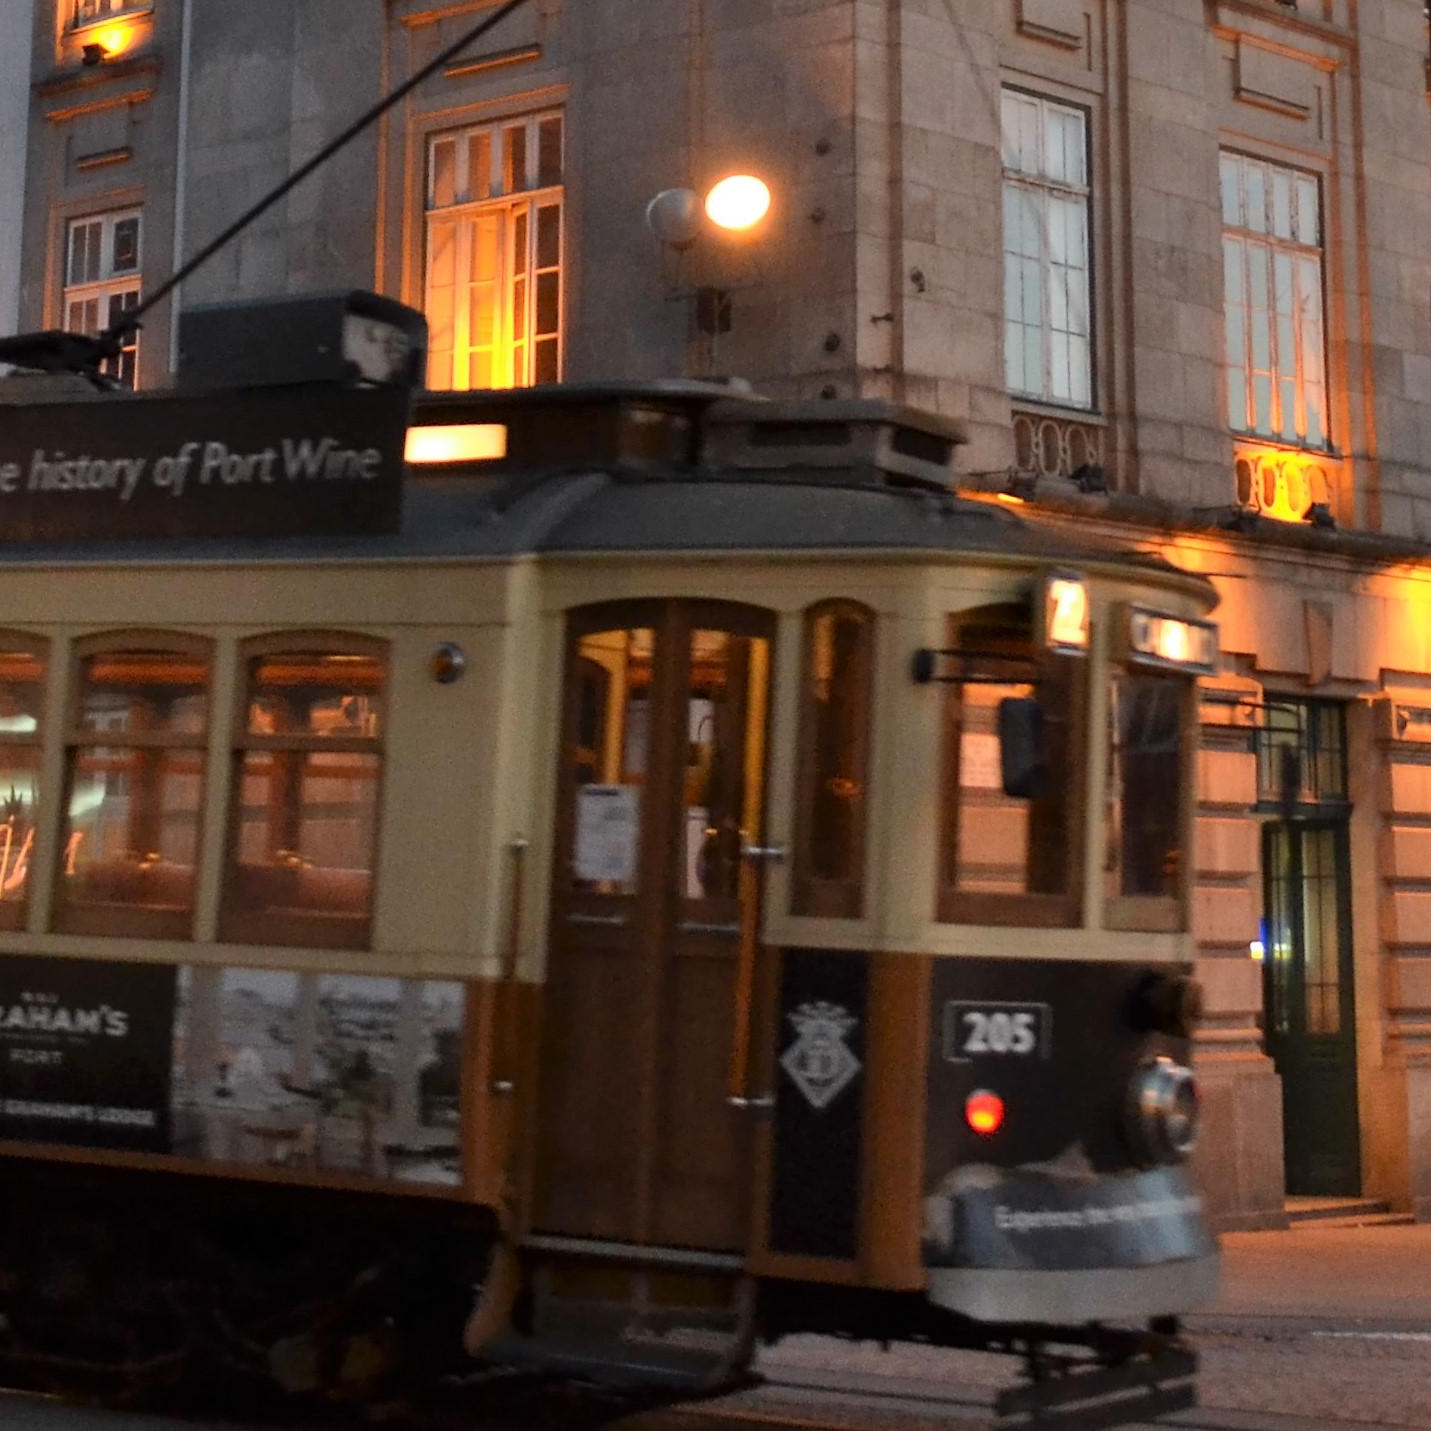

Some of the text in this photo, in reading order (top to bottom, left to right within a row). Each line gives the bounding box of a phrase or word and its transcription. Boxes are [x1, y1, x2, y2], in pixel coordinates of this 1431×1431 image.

[27, 448, 146, 502] history
[152, 440, 200, 497] of
[199, 440, 278, 485] Port
[281, 436, 383, 481] Wine
[961, 1011, 1036, 1053] 205
